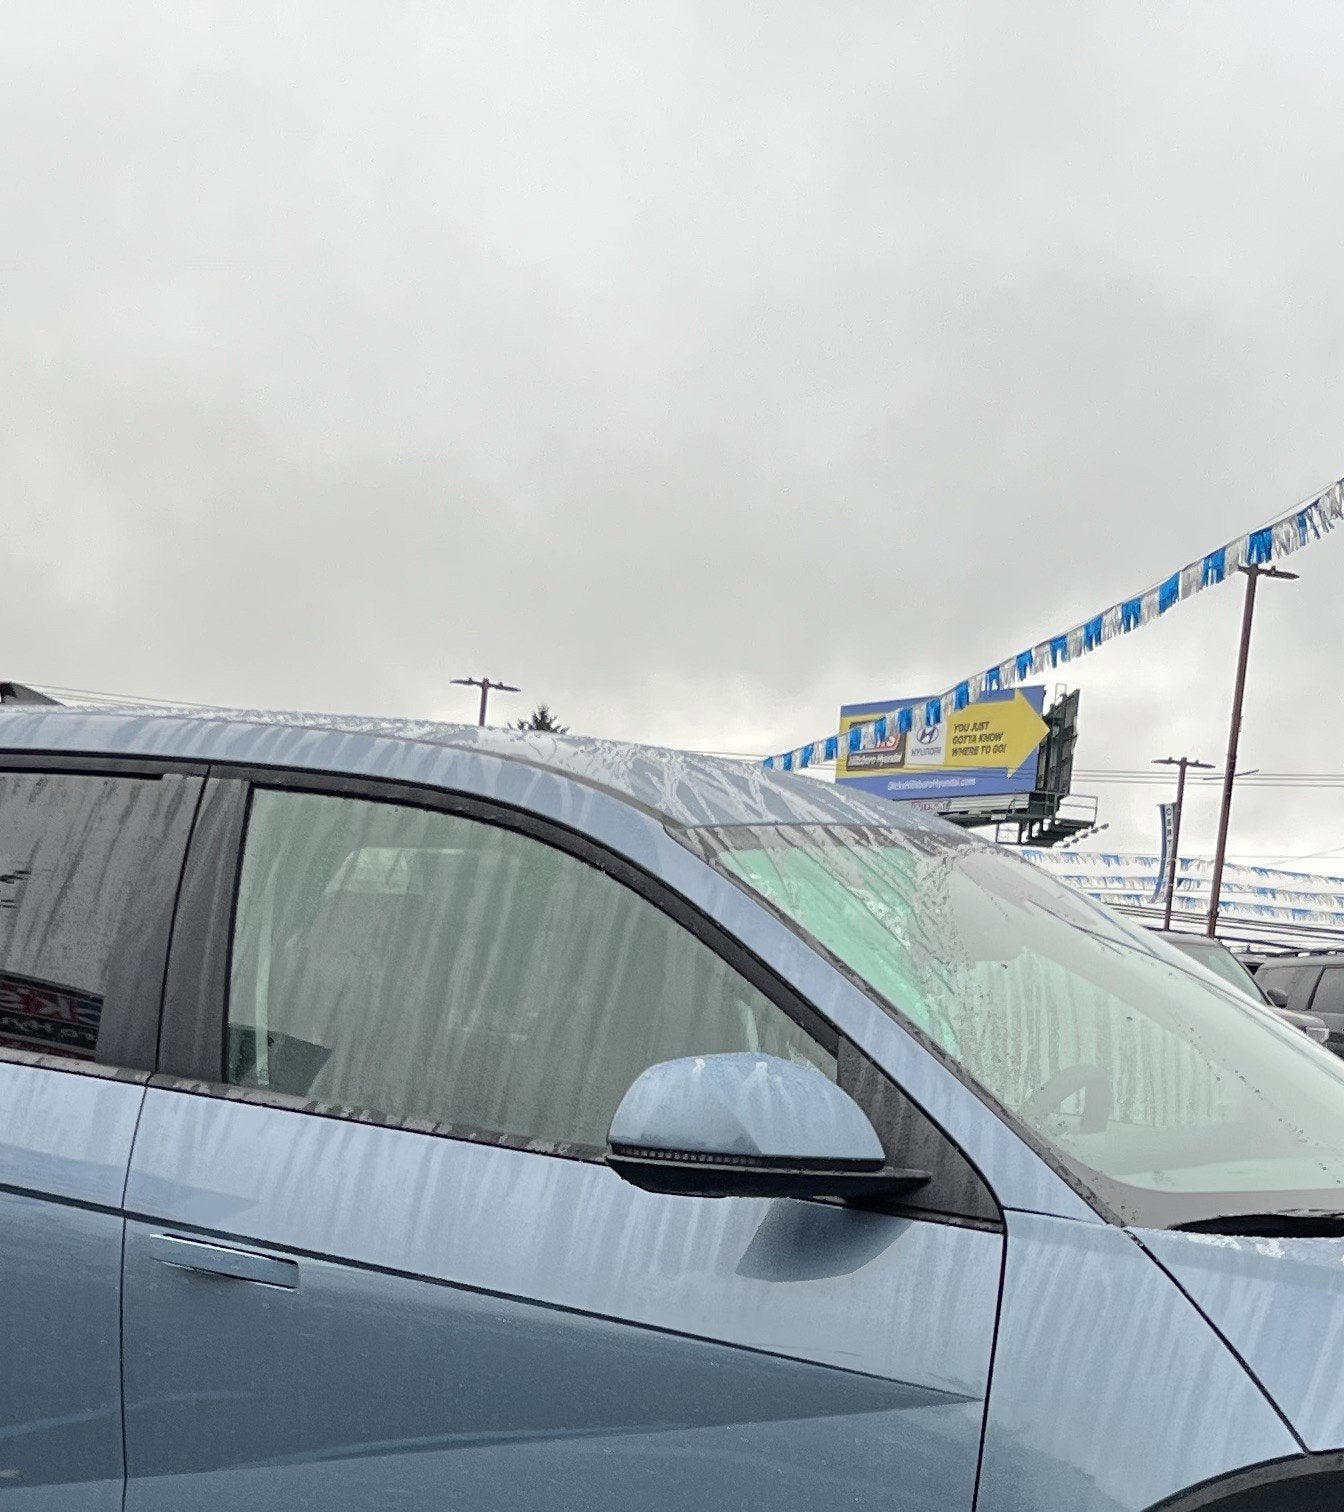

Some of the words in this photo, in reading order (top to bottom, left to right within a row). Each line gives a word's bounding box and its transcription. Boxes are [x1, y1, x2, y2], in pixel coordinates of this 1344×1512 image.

[954, 722, 970, 733] YOU
[970, 721, 990, 732] JUST
[952, 734, 977, 745] GOTTA
[979, 731, 1004, 743] KNOW
[911, 746, 942, 758] HYUNDAI
[952, 745, 980, 757] WHERE
[981, 744, 992, 755] TO
[992, 743, 1008, 754] GO!
